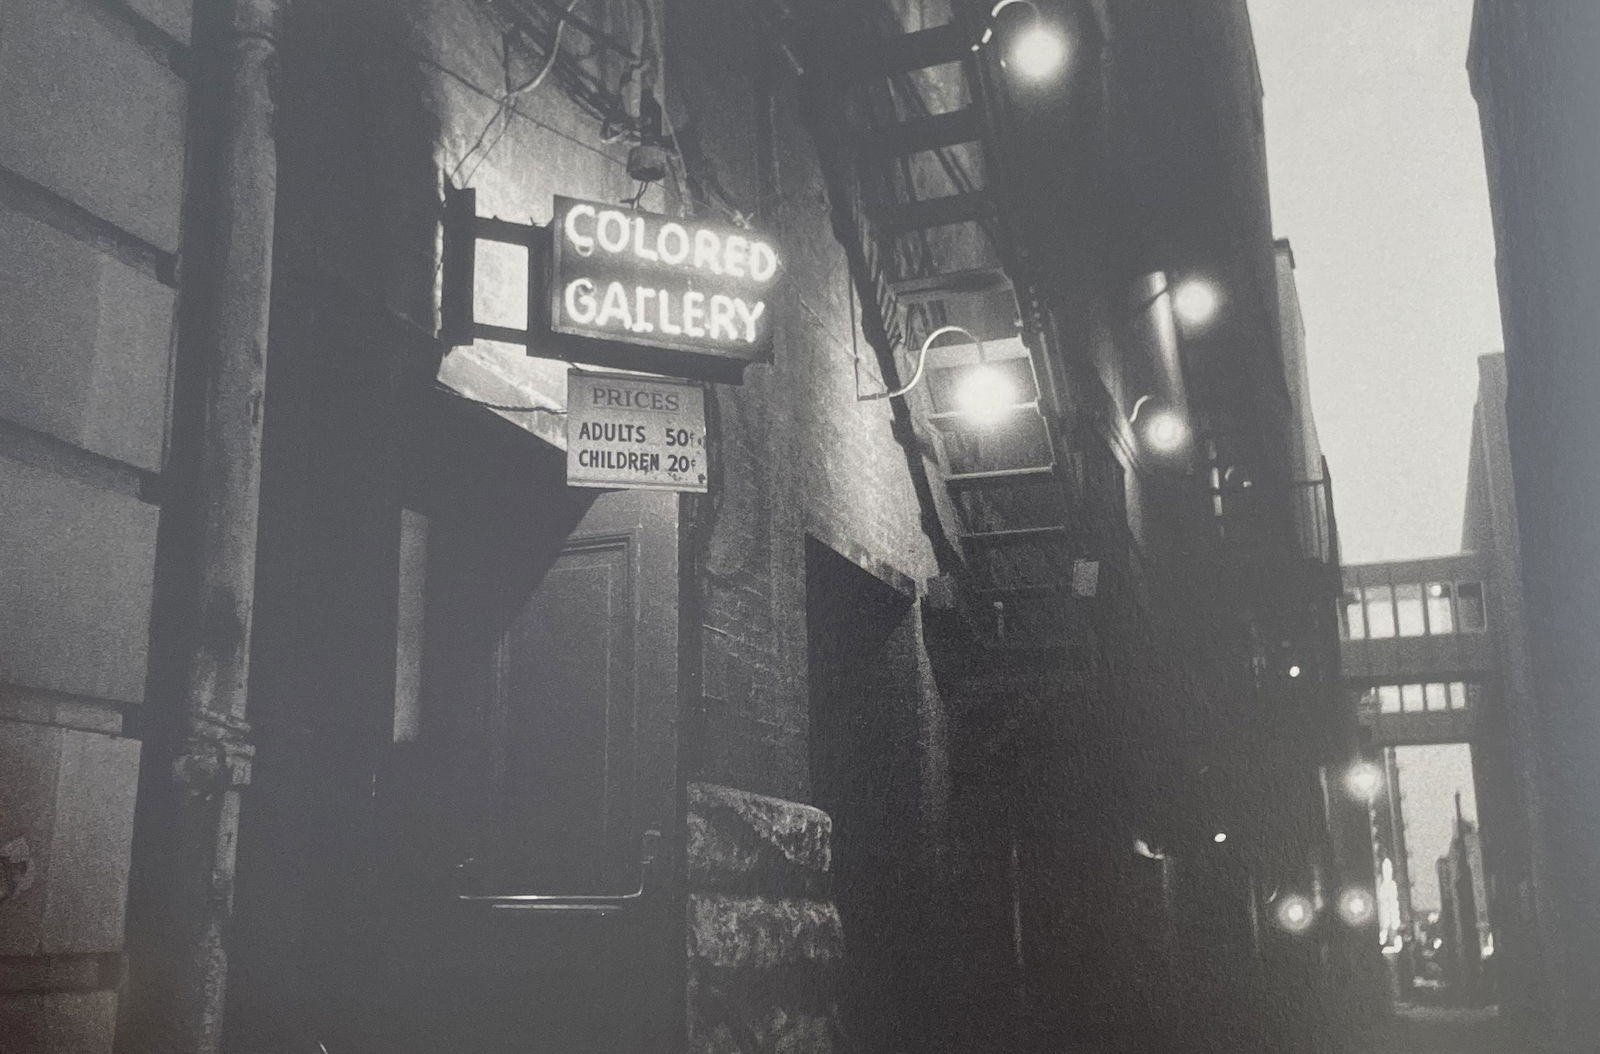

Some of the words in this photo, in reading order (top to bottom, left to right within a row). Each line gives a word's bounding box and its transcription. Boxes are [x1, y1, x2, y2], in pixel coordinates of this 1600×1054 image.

[565, 204, 777, 282] COLORED
[593, 387, 680, 412] PRICES
[579, 422, 646, 443] ADULTS
[579, 450, 660, 471] CHILDREN
